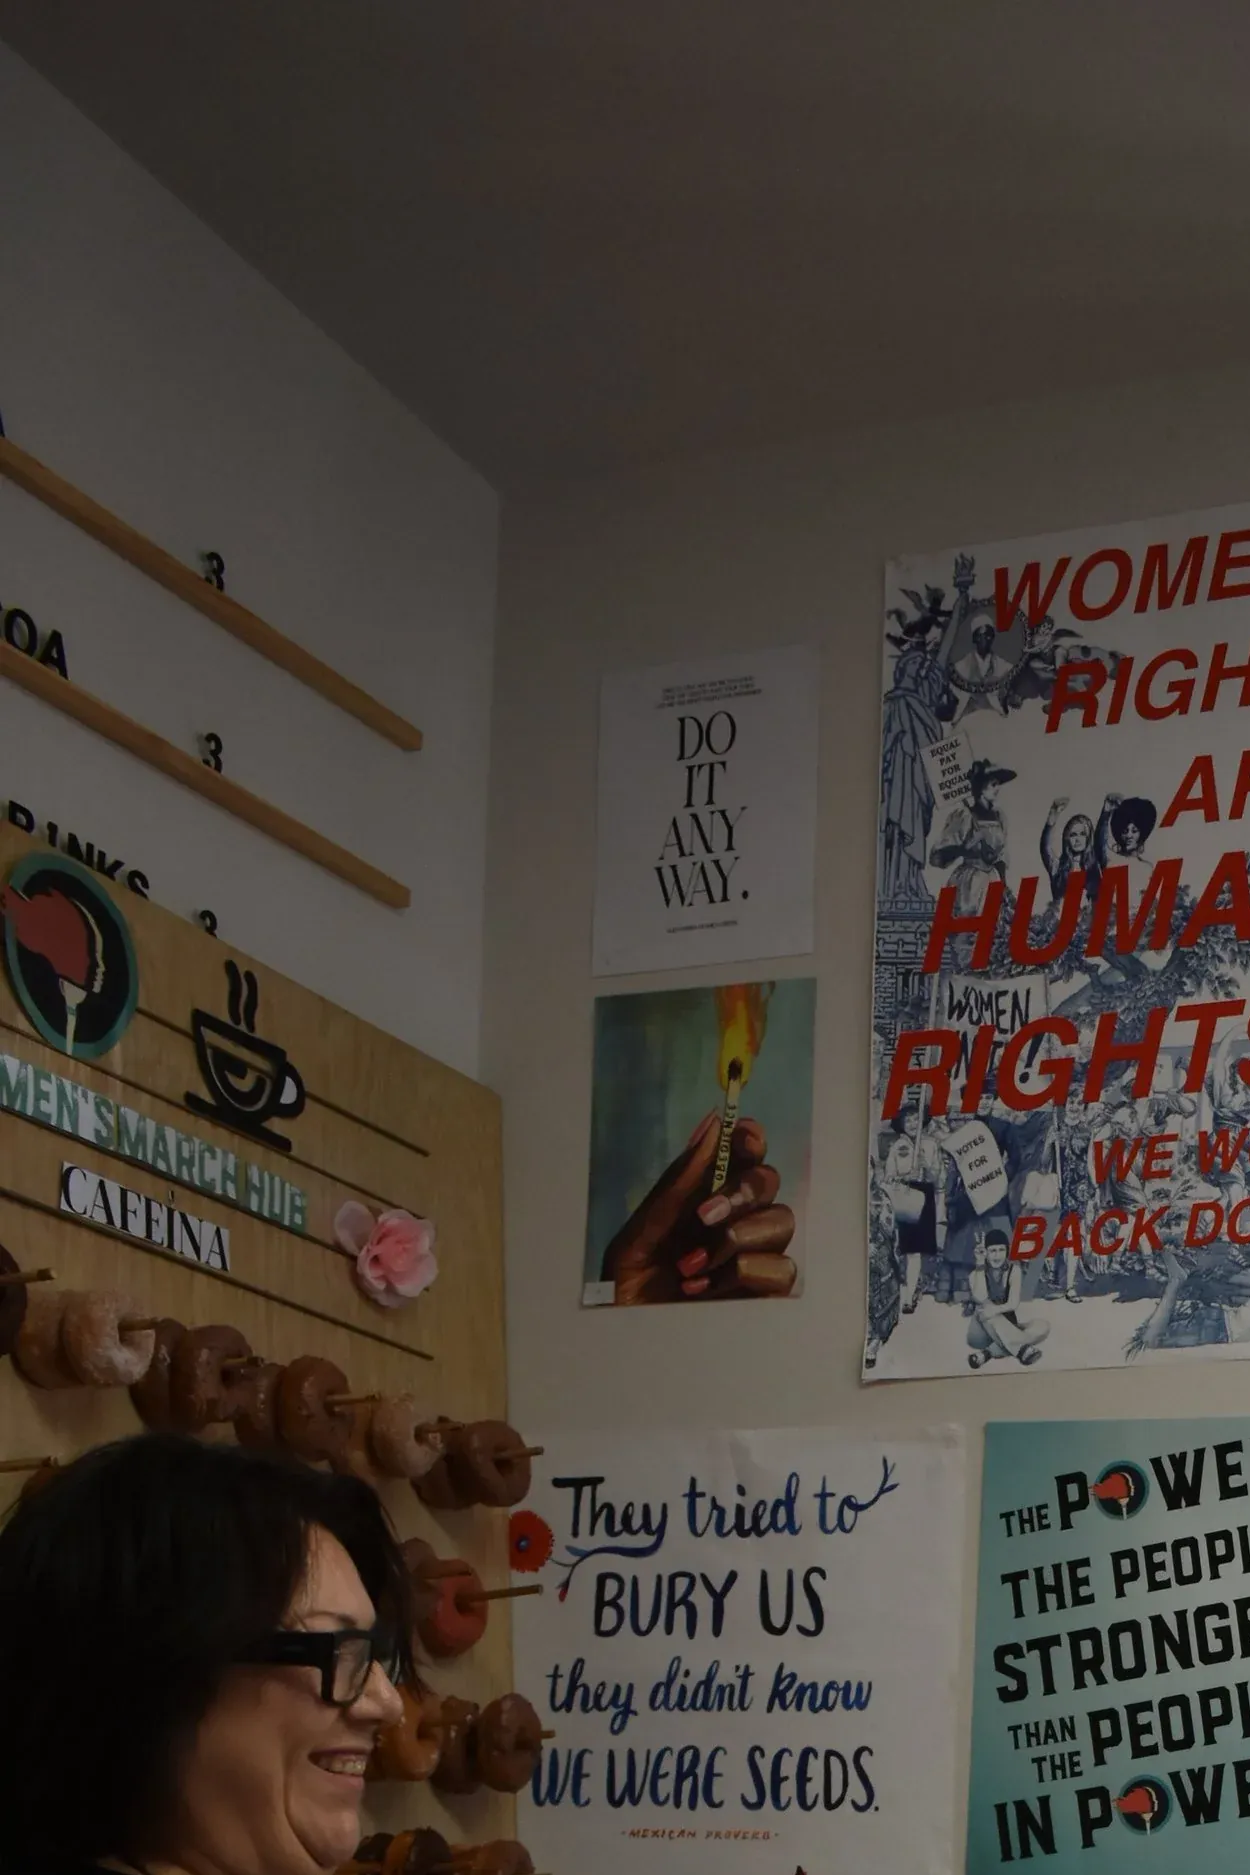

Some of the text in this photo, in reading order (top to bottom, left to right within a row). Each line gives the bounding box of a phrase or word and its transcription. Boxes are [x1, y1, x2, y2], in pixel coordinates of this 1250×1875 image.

[0, 604, 70, 681] OA
[676, 711, 736, 761] DO
[930, 739, 961, 758] EQUAL
[939, 752, 956, 766] PAY
[683, 761, 727, 808] IT
[941, 764, 961, 777] FOR
[658, 806, 748, 860] ANY
[654, 856, 749, 908] WAY.
[948, 981, 1030, 1035] WOMEN
[956, 1135, 986, 1156] VOTES
[968, 1154, 988, 1171] FOR
[1092, 1134, 1178, 1184] WE
[968, 1167, 1003, 1191] WOMEN
[1008, 1207, 1171, 1261] BACK
[552, 1466, 874, 1559] They tried to
[1000, 1503, 1051, 1538] THE
[593, 1566, 827, 1640] BURY US
[1001, 1556, 1096, 1618] THE
[545, 1657, 639, 1735] they
[766, 1662, 872, 1714] know
[1007, 1715, 1077, 1751] THAN
[532, 1745, 880, 1813] WE WERE SEEDS.
[1031, 1750, 1083, 1783] THE
[993, 1794, 1058, 1863] IN
